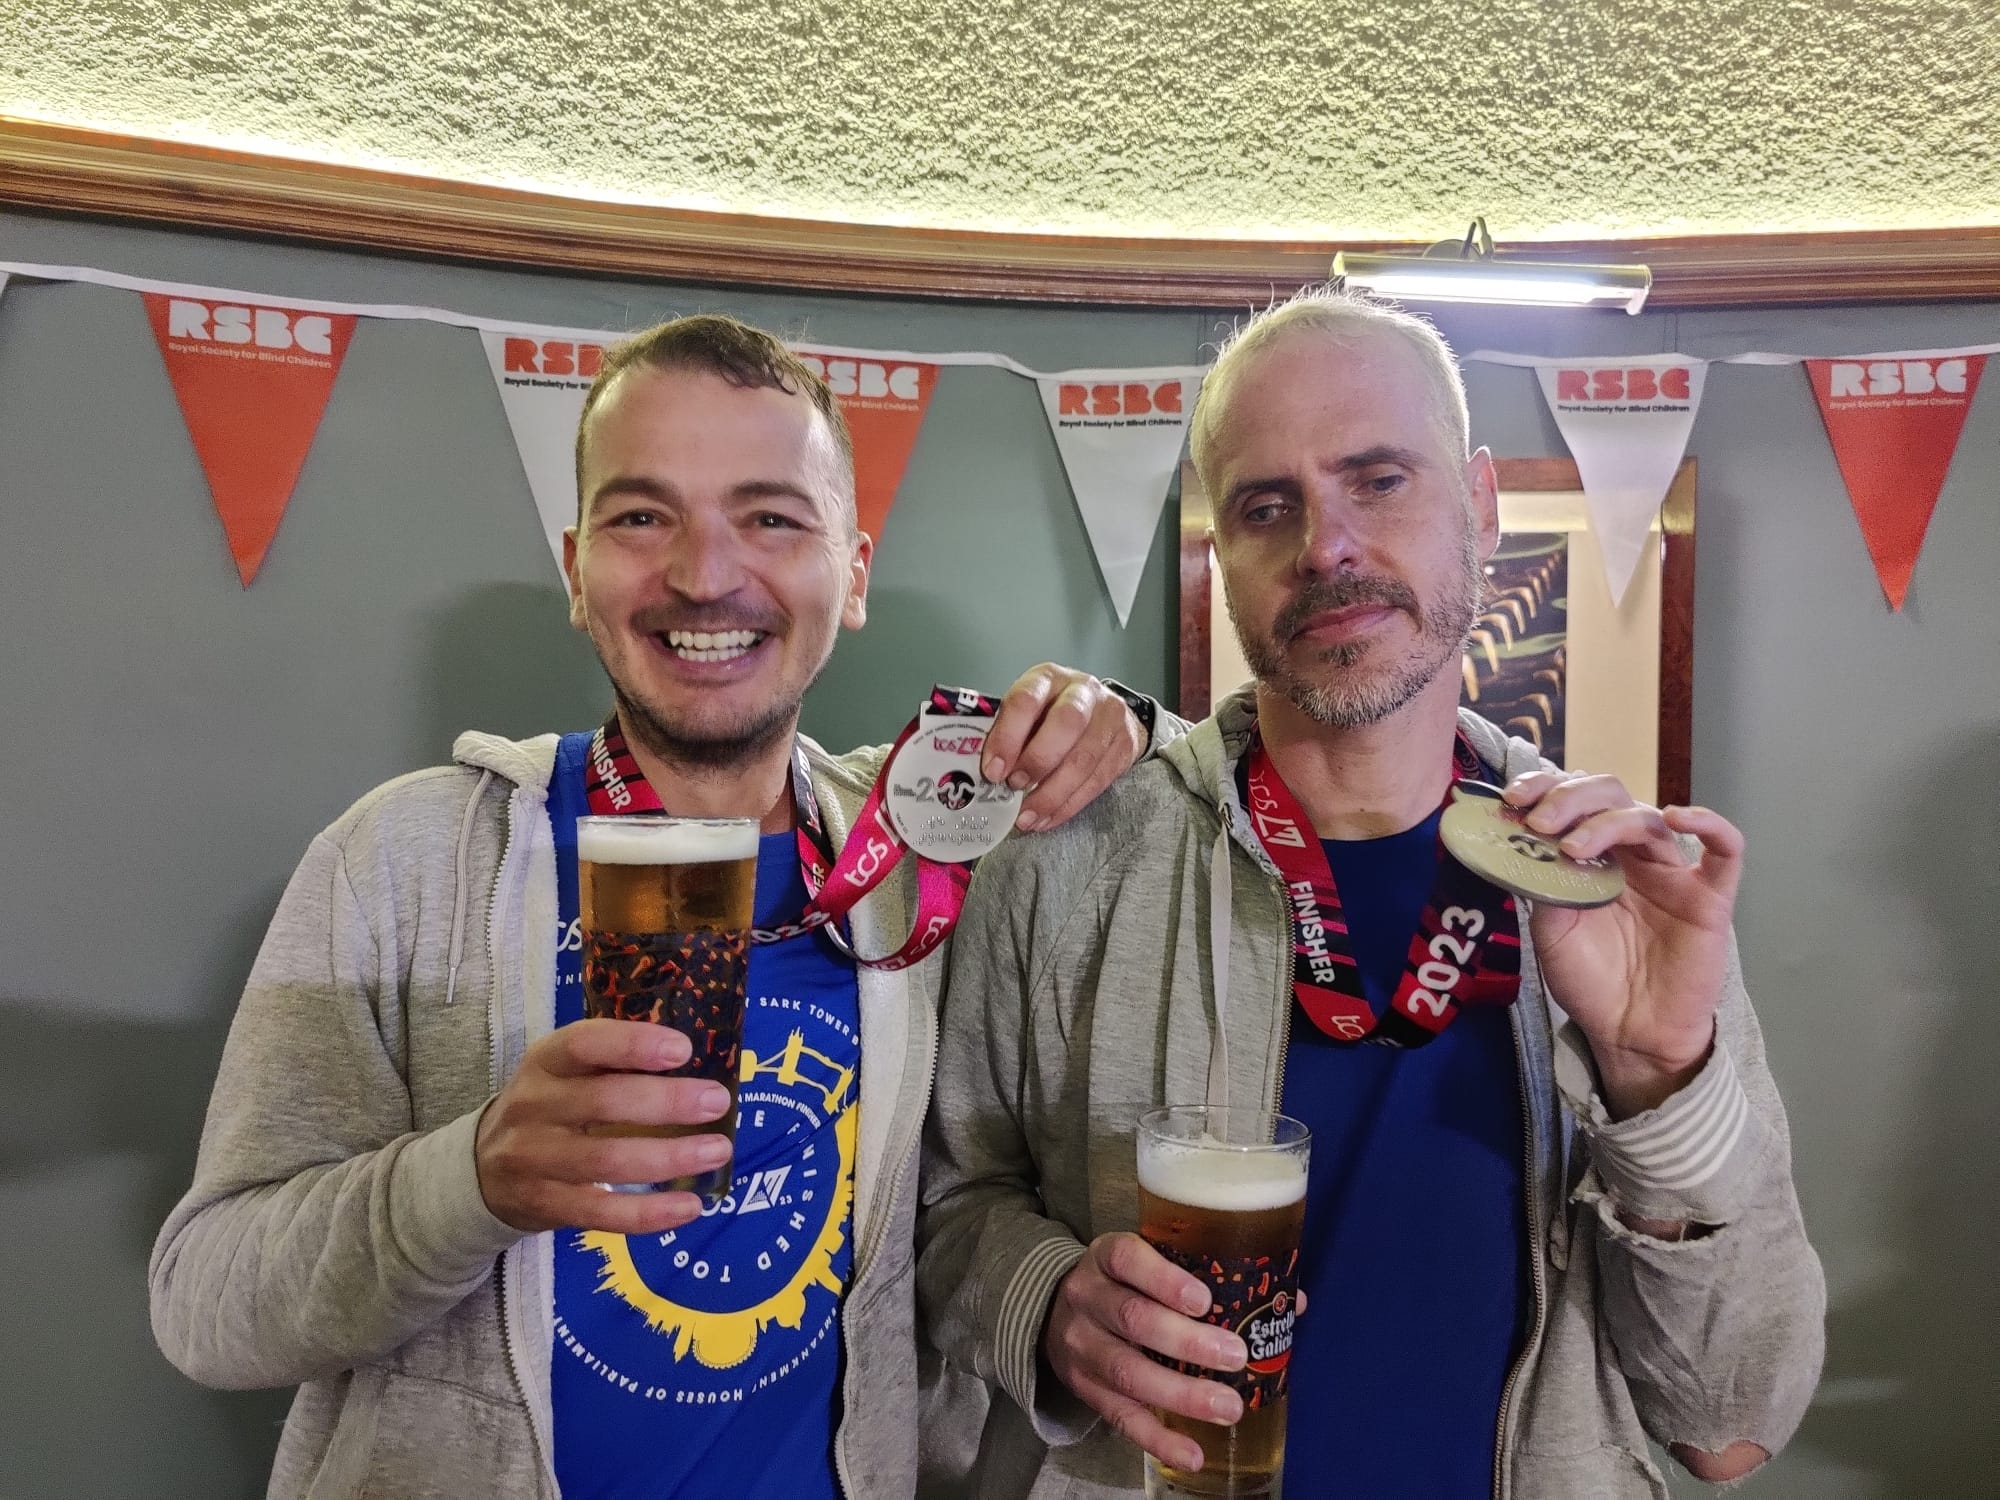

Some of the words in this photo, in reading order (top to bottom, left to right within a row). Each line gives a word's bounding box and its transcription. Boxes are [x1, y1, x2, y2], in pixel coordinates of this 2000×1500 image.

[168, 300, 332, 355] RSBC
[169, 342, 199, 354] Royal
[201, 345, 240, 359] Society
[241, 350, 257, 360] for
[258, 352, 285, 363] Blind
[287, 355, 332, 369] Children
[504, 337, 604, 377] RSB
[1558, 368, 1690, 401] RSBC
[1831, 359, 1967, 397] RSBC
[1059, 382, 1182, 416] RSBC
[750, 911, 831, 943] 023
[1290, 880, 1336, 984] FINISHER
[1406, 905, 1486, 1017] 2023
[759, 996, 802, 1011] SARK
[808, 1004, 851, 1037] TOWER
[744, 1092, 796, 1109] MARATHON
[1248, 1309, 1295, 1340] Estrell
[644, 1387, 667, 1400] OF
[676, 1388, 743, 1404] HOUSES
